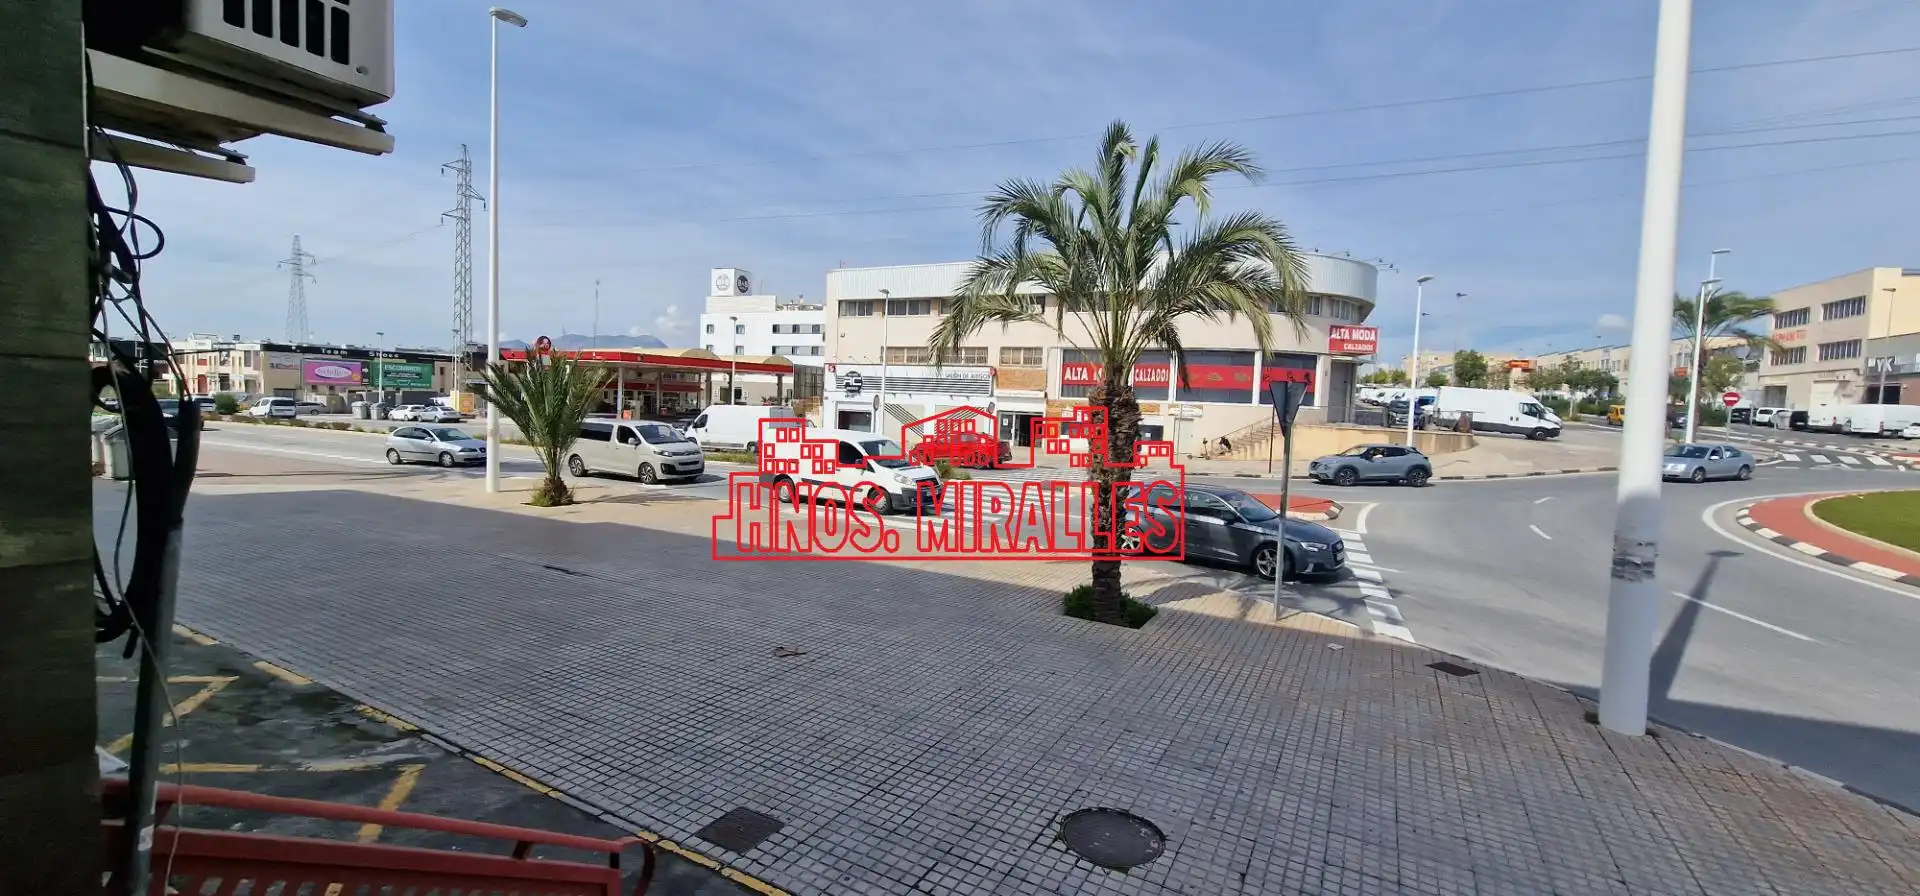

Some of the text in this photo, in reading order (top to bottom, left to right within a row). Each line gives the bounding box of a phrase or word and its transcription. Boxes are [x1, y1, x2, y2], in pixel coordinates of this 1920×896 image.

[1330, 327, 1376, 341] ALTA MODA
[1343, 343, 1374, 351] CALZADOS
[368, 351, 400, 359] Shoes
[1064, 367, 1088, 381] ALTA
